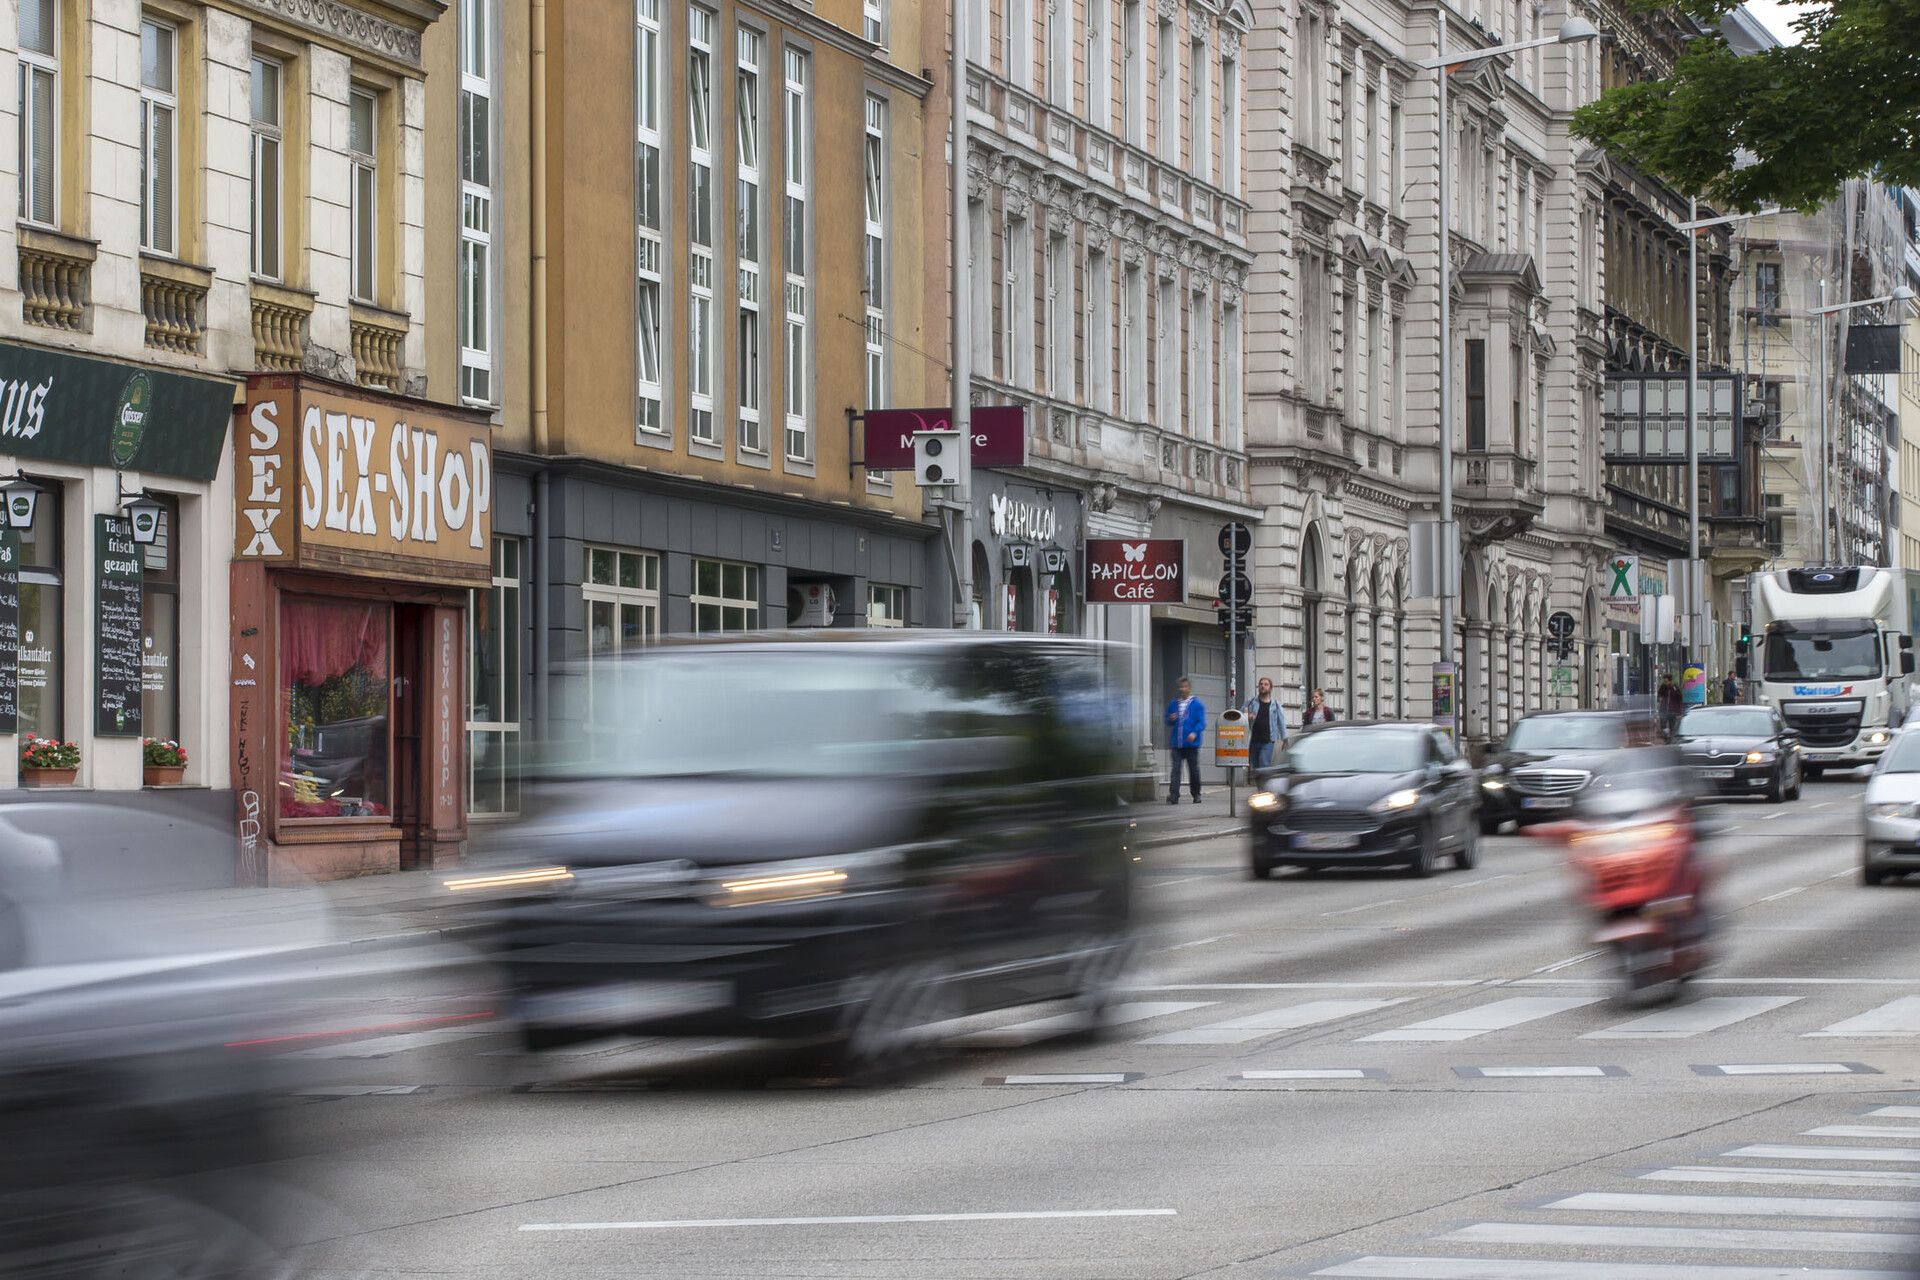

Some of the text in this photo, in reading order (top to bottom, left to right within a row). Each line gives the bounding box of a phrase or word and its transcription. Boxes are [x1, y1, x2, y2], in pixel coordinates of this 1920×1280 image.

[242, 400, 283, 556] SEX
[302, 404, 490, 549] SEX-SHOP
[1008, 499, 1056, 541] PAPILLON
[0, 546, 12, 562] aß
[108, 538, 135, 554] frisch
[104, 559, 139, 575] gezapft
[1091, 563, 1177, 580] PAPILLON
[1113, 583, 1155, 599] Café
[441, 617, 450, 788] SEX SHOP
